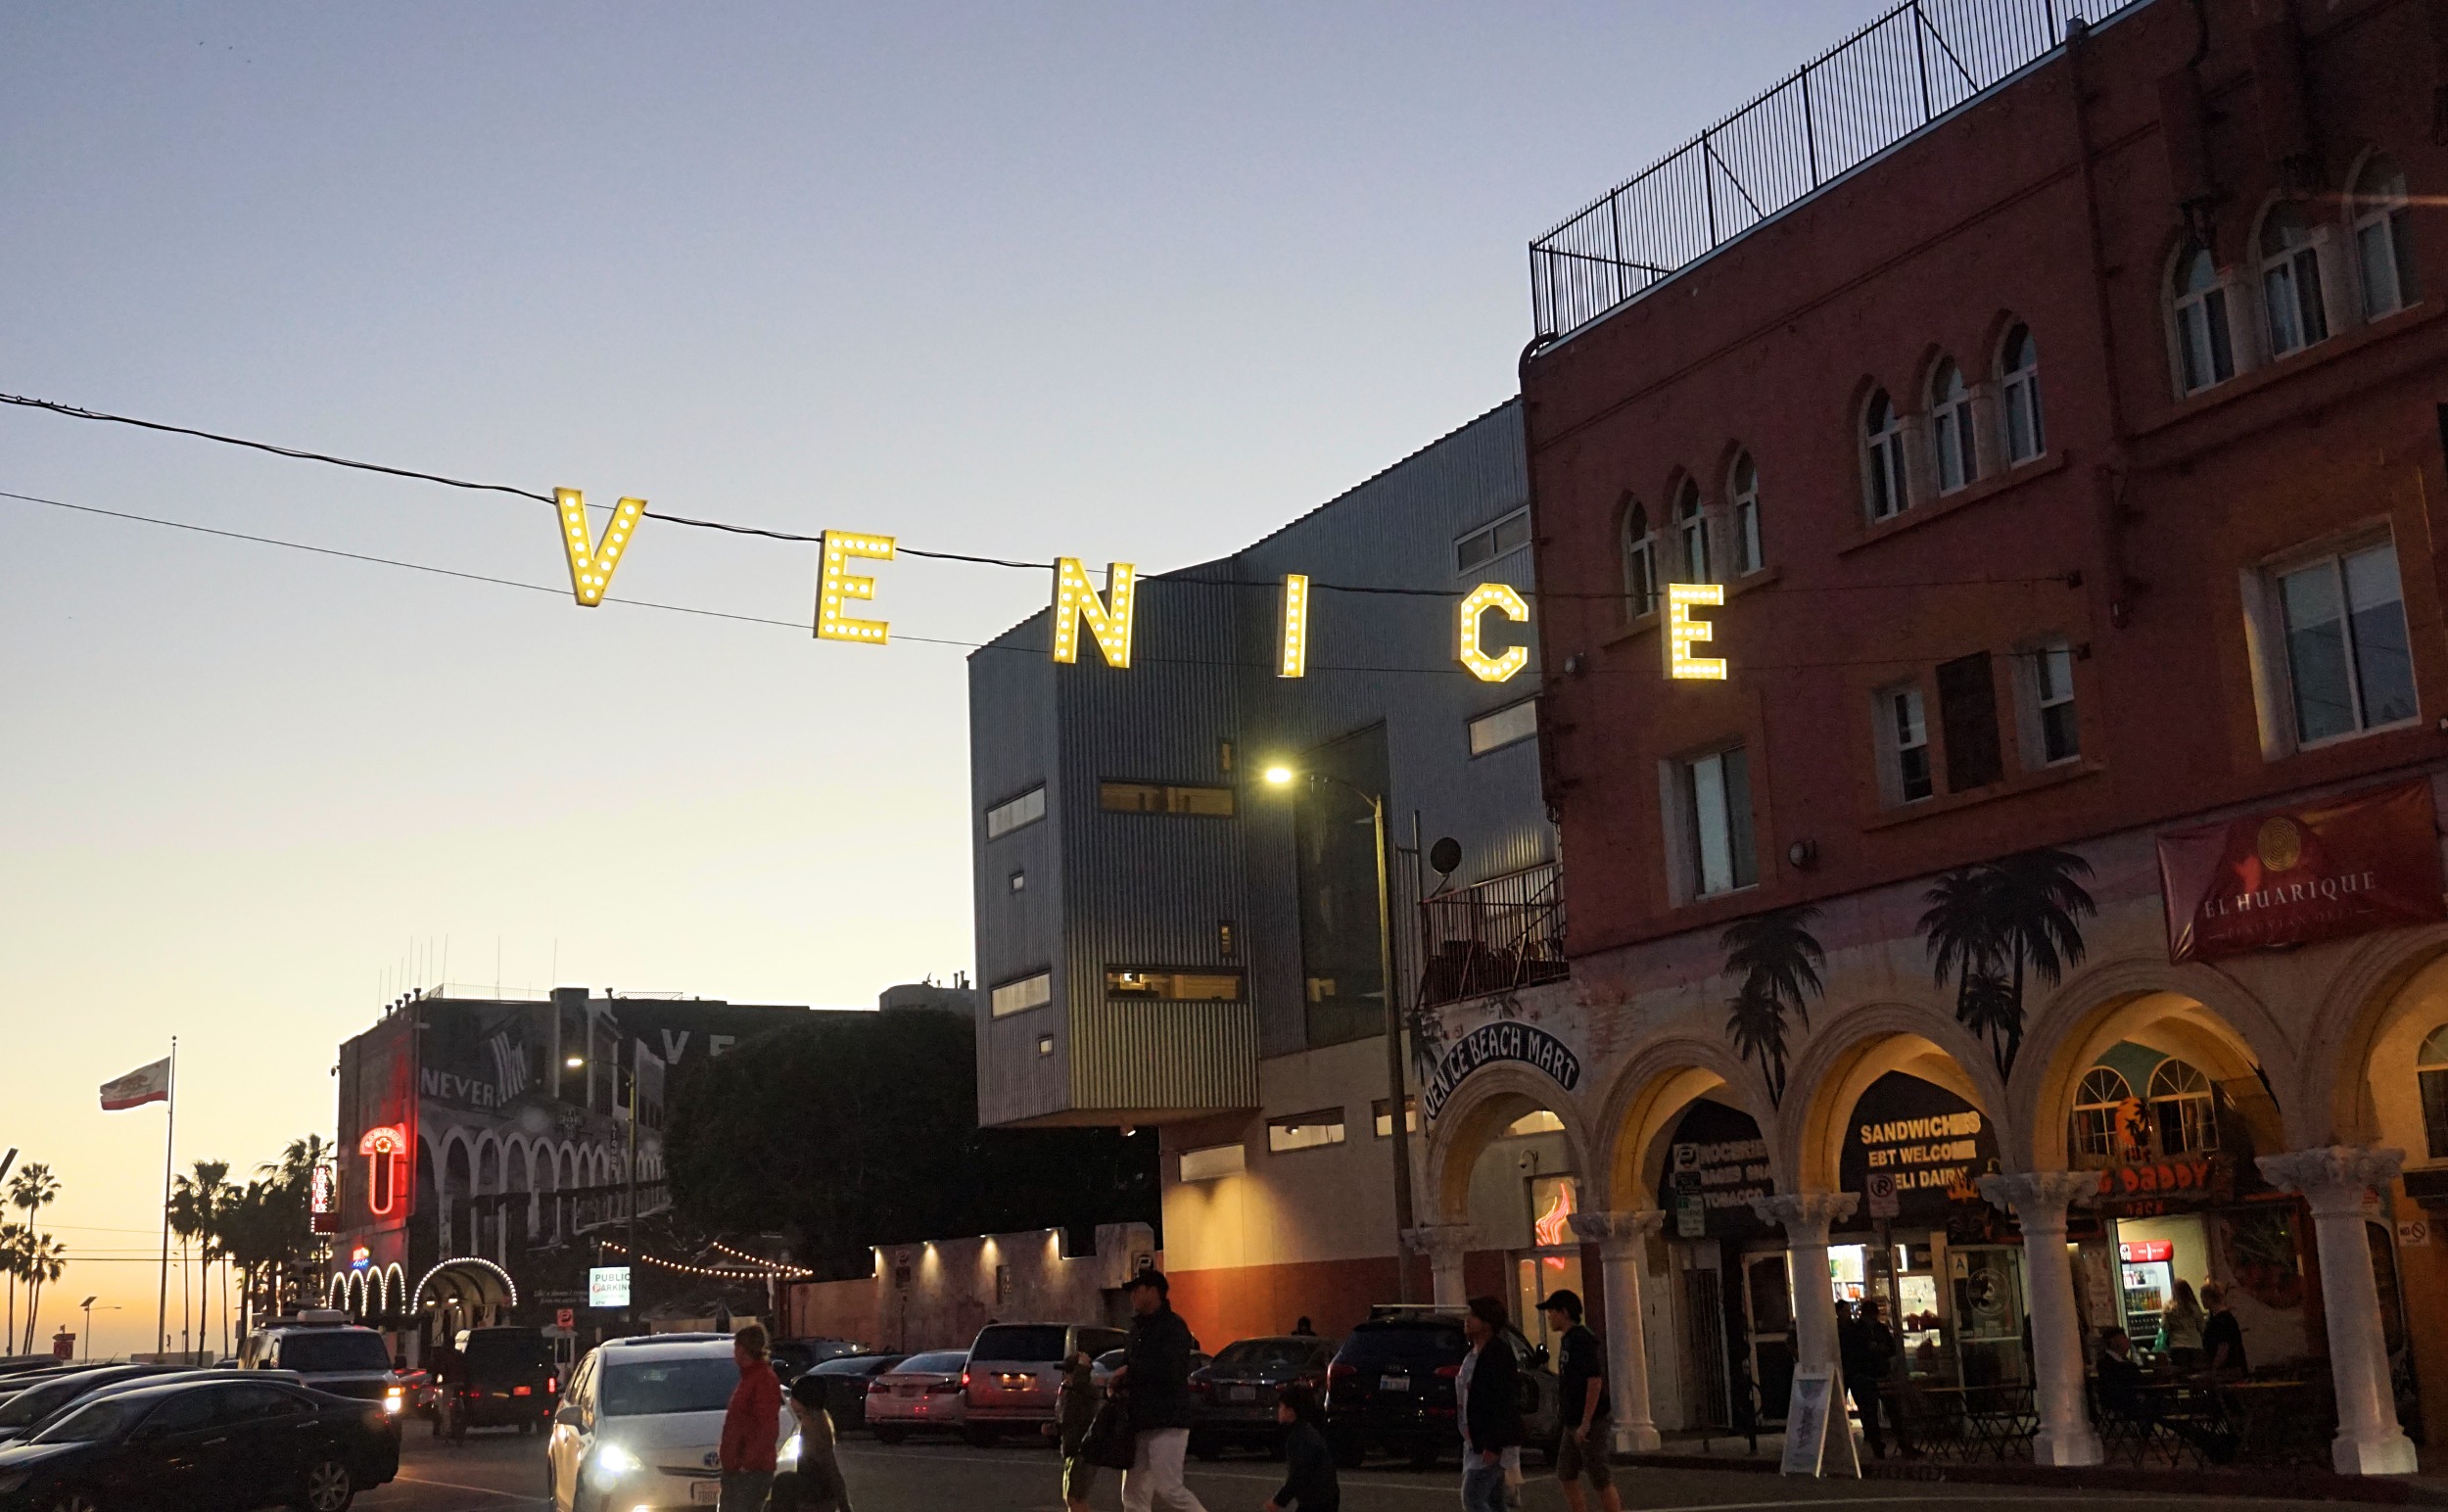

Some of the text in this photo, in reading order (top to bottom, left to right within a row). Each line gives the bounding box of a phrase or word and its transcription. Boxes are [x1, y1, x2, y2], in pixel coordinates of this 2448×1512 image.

[551, 486, 1727, 683] VENICE
[2204, 871, 2377, 920] EL HUARIQUE
[1469, 1025, 1521, 1065] BEACH
[1528, 1030, 1576, 1088] MART
[420, 1065, 495, 1109] NEVER
[1868, 1149, 1898, 1167] EBT
[1895, 1172, 1916, 1191] ELI
[594, 1273, 631, 1283] PUBLIC
